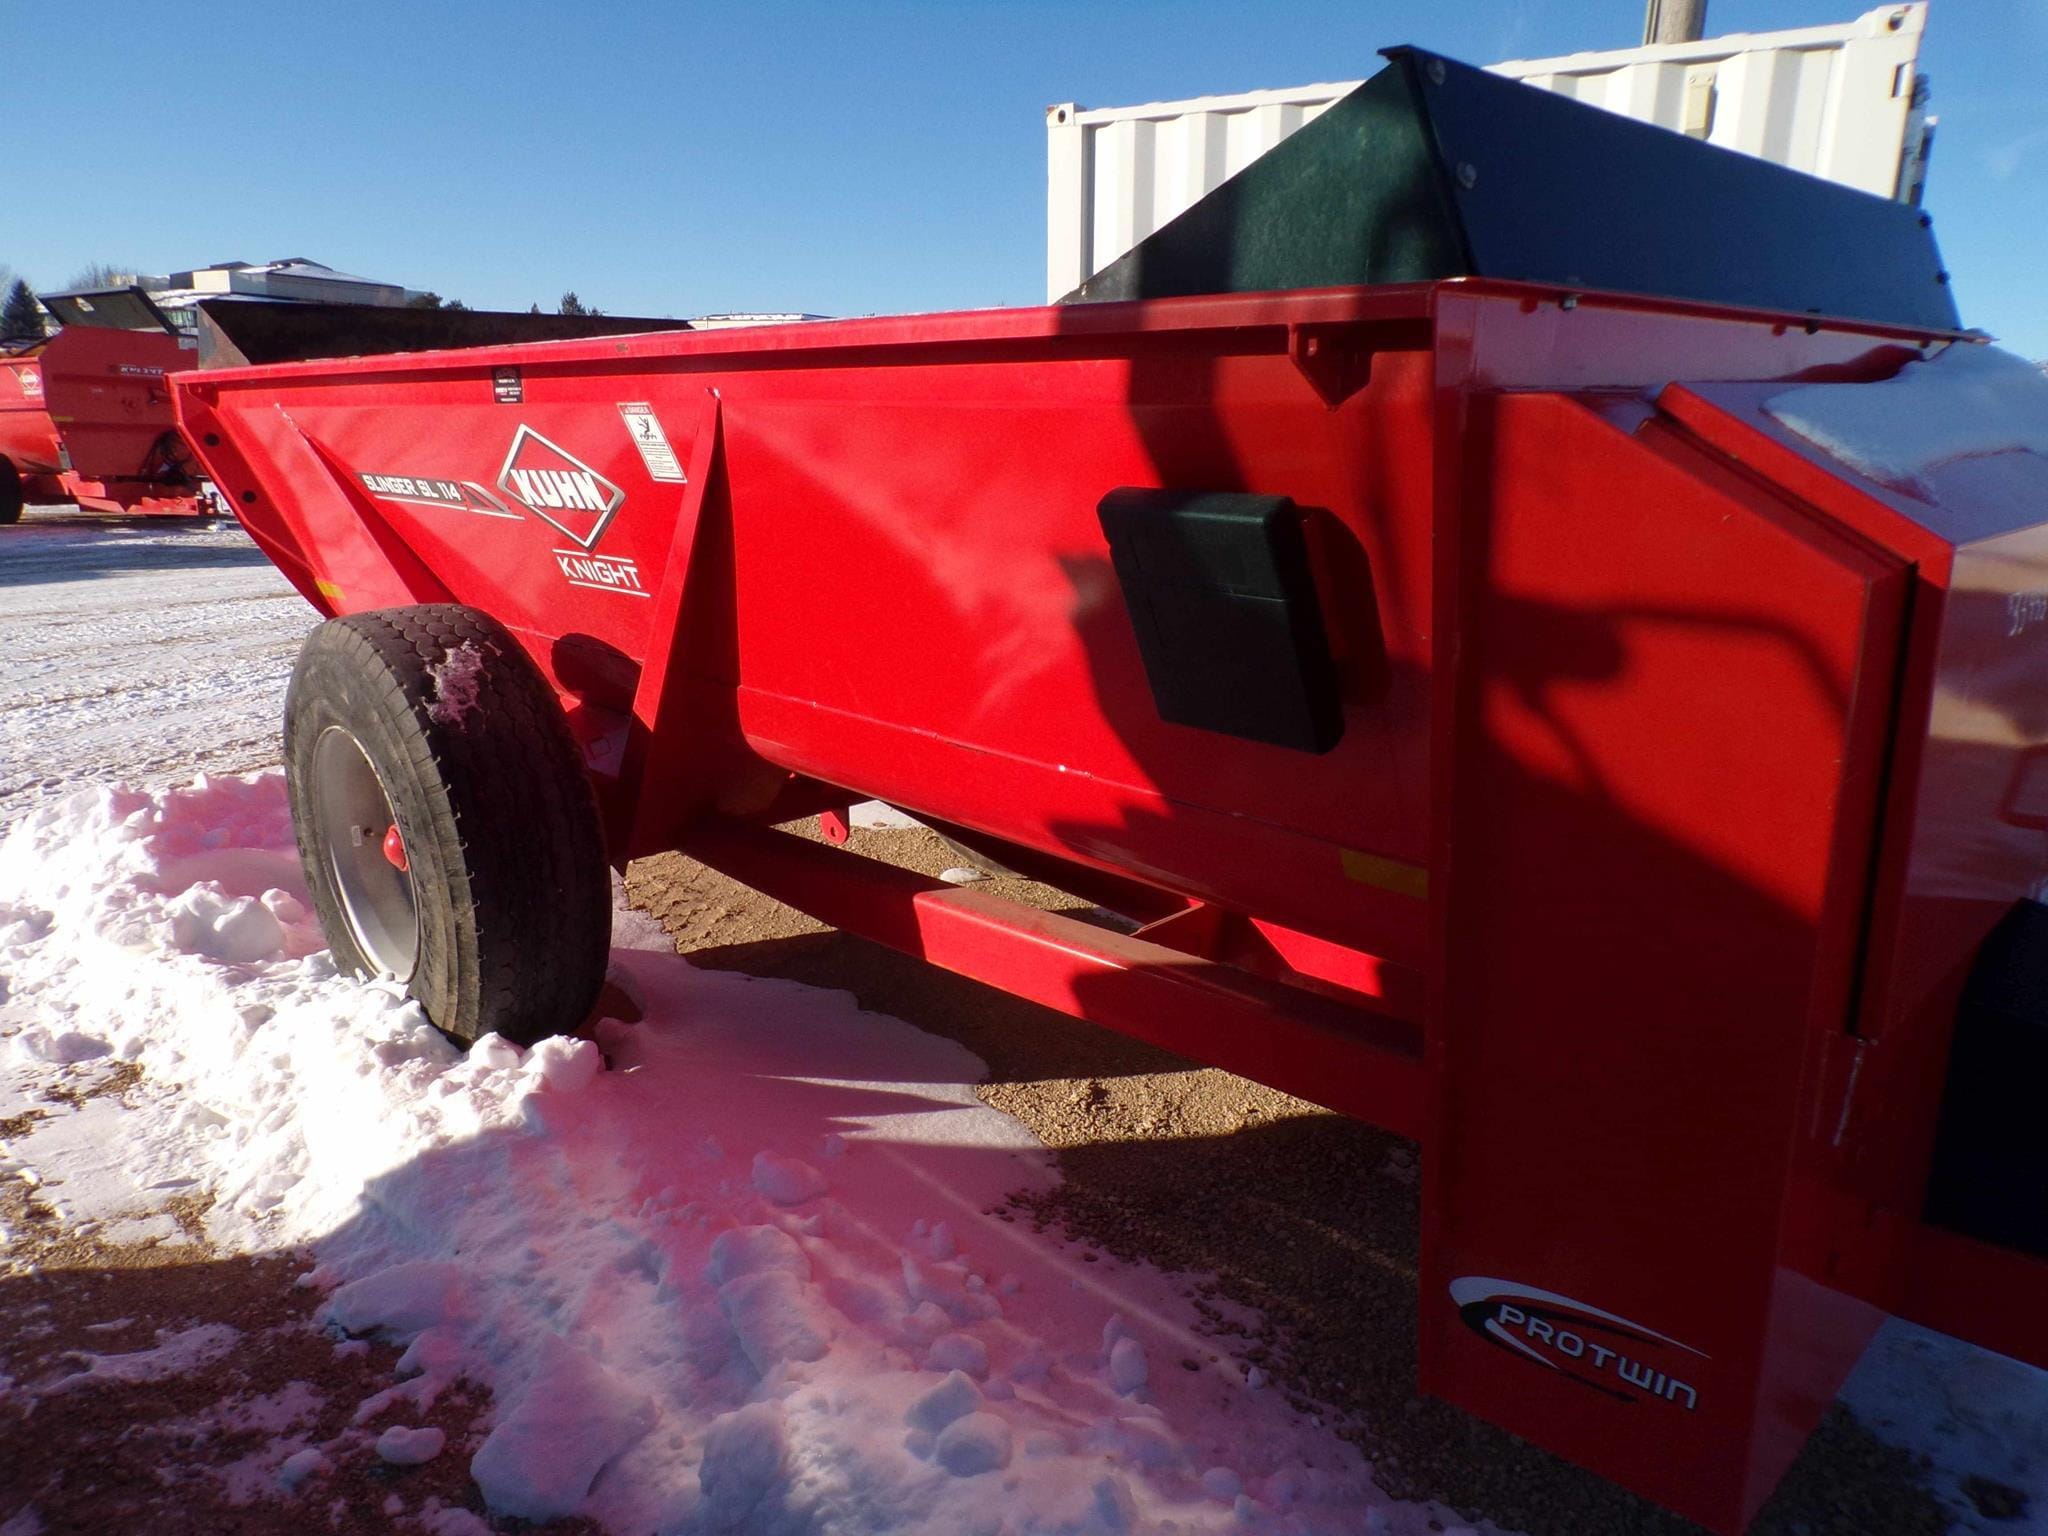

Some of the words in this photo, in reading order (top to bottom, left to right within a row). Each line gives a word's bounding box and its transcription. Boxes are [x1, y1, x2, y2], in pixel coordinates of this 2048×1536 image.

[361, 474, 419, 496] SLINGER
[415, 479, 440, 498] SL
[436, 481, 462, 501] 114
[510, 469, 608, 512] KUHN
[556, 555, 641, 589] KNIGHT
[1499, 1303, 1698, 1410] PROTWIN
